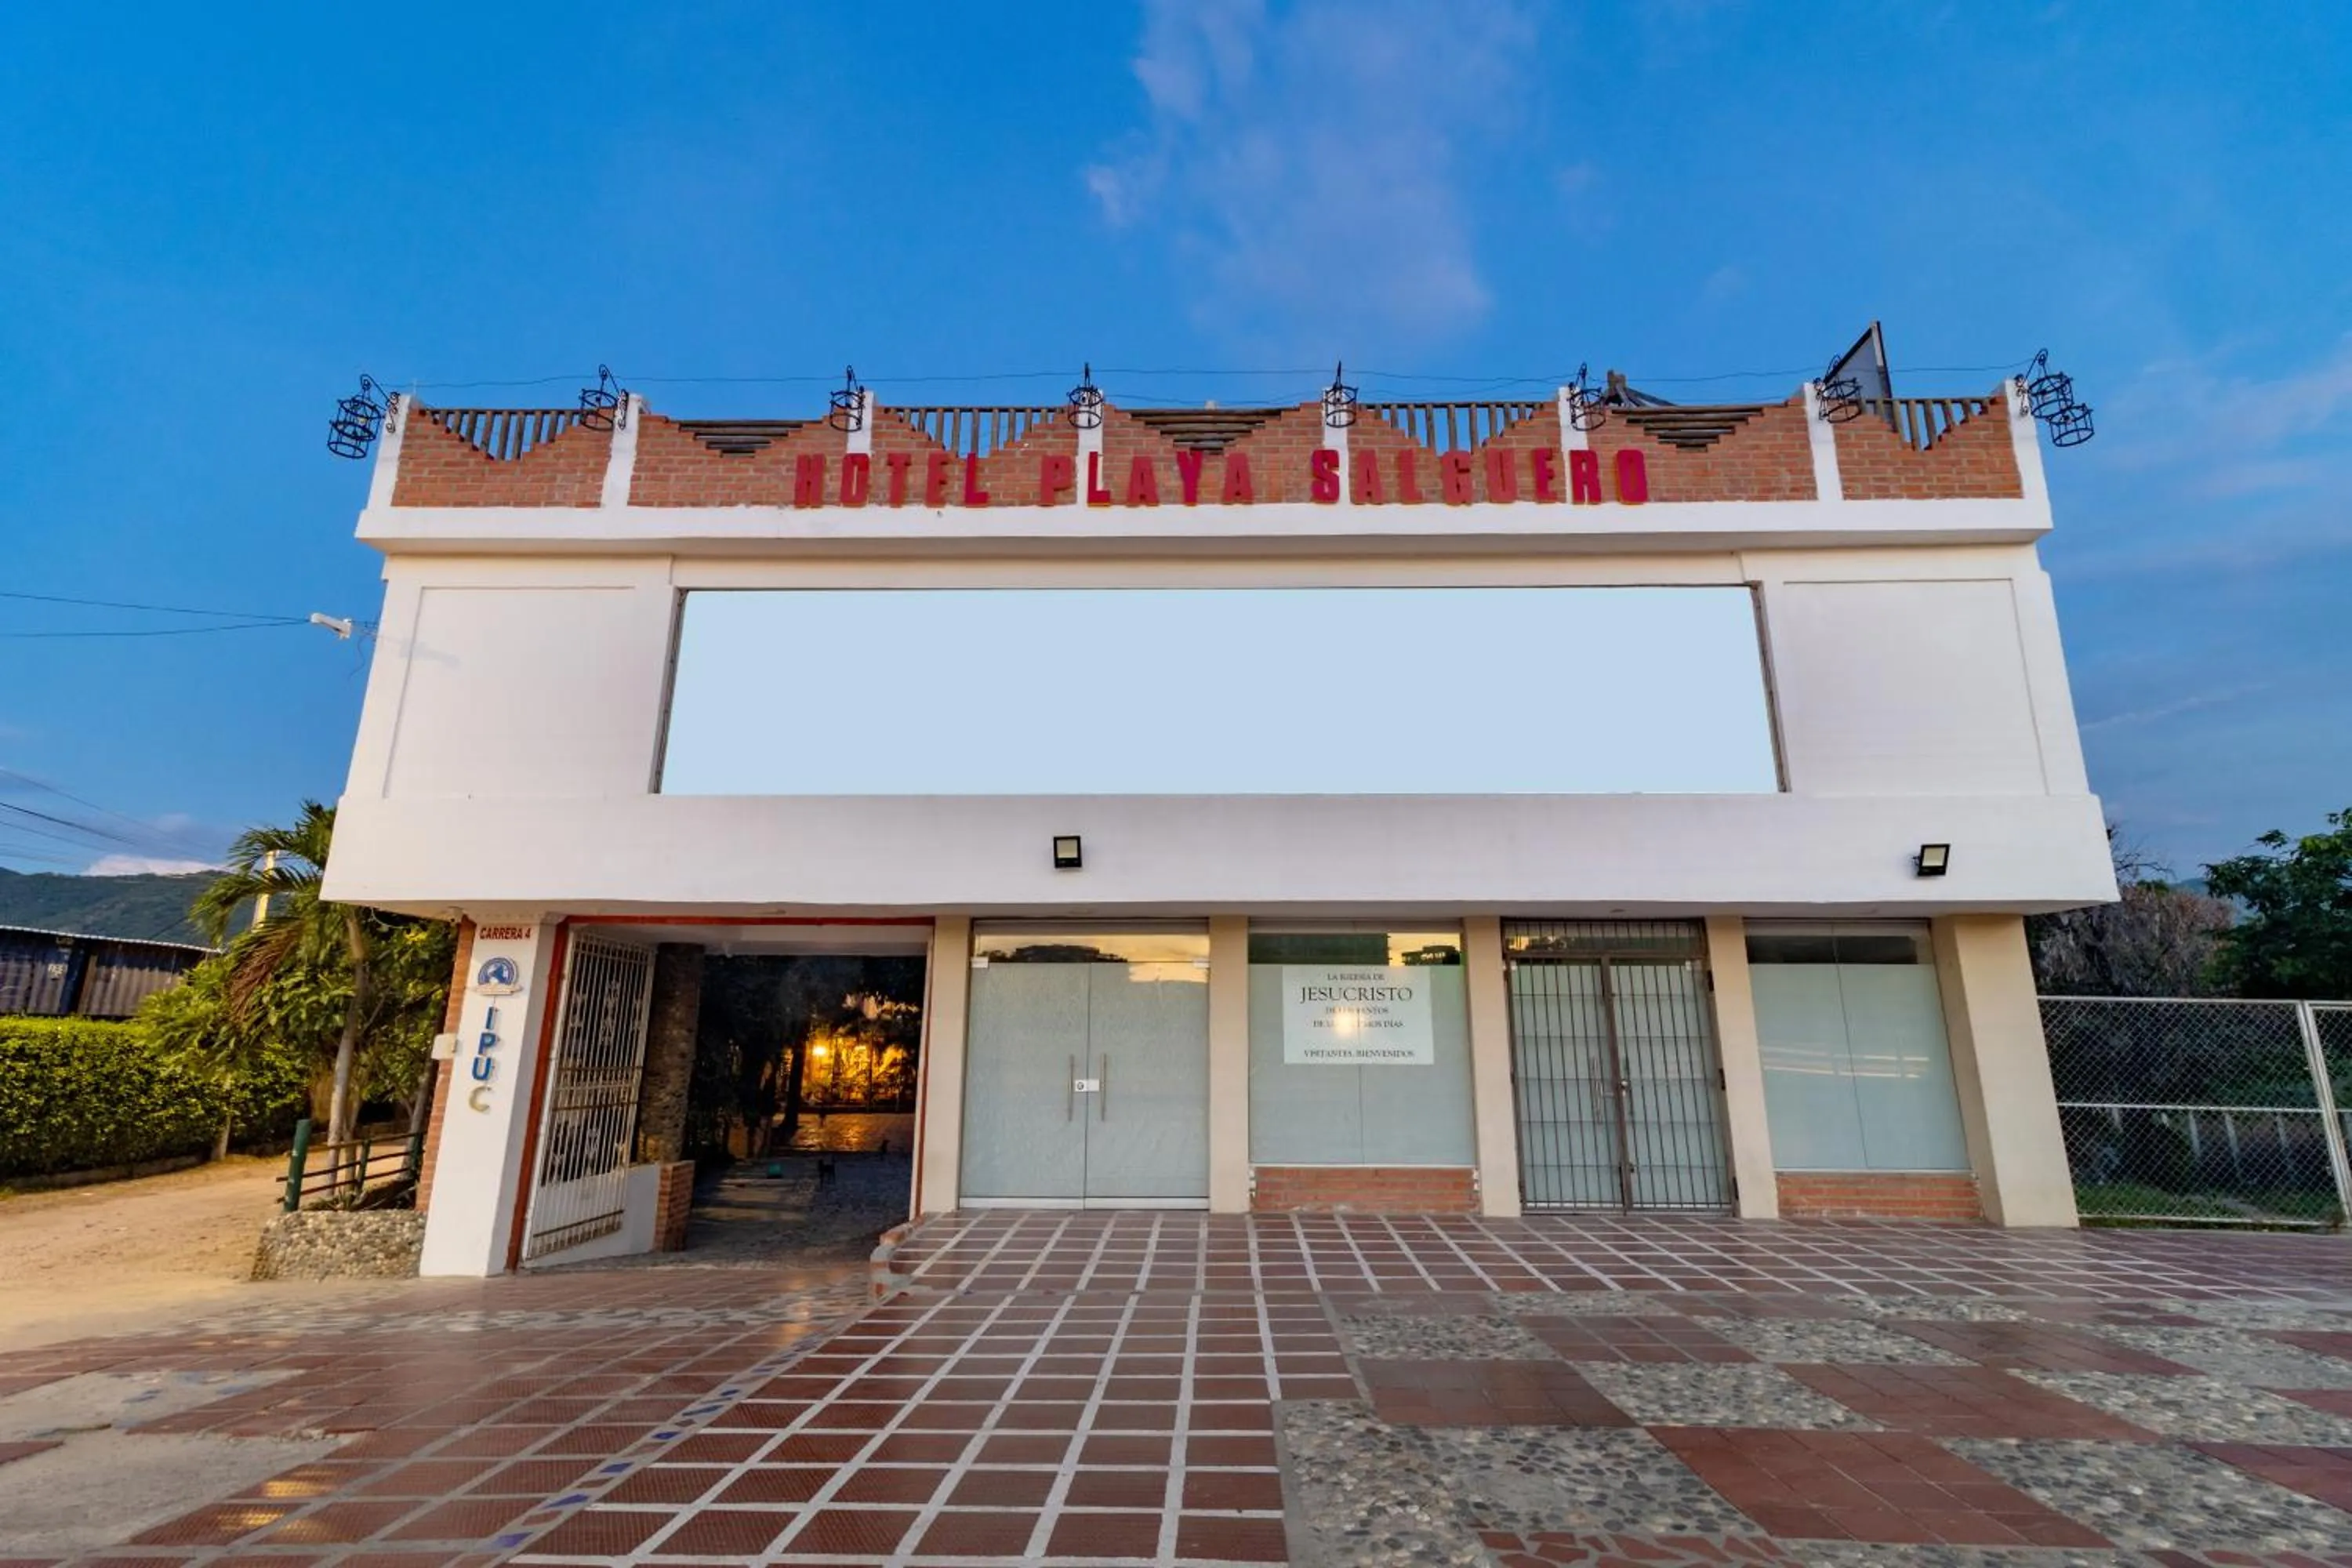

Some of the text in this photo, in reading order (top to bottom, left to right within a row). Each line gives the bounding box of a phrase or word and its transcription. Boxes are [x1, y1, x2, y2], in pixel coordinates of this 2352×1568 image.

[794, 448, 1649, 508] HOTEL PLAYA SALGUERO
[480, 927, 531, 939] CARRERA 4
[1300, 987, 1413, 1004] JESUCRISTO
[468, 1006, 498, 1113] IPUC
